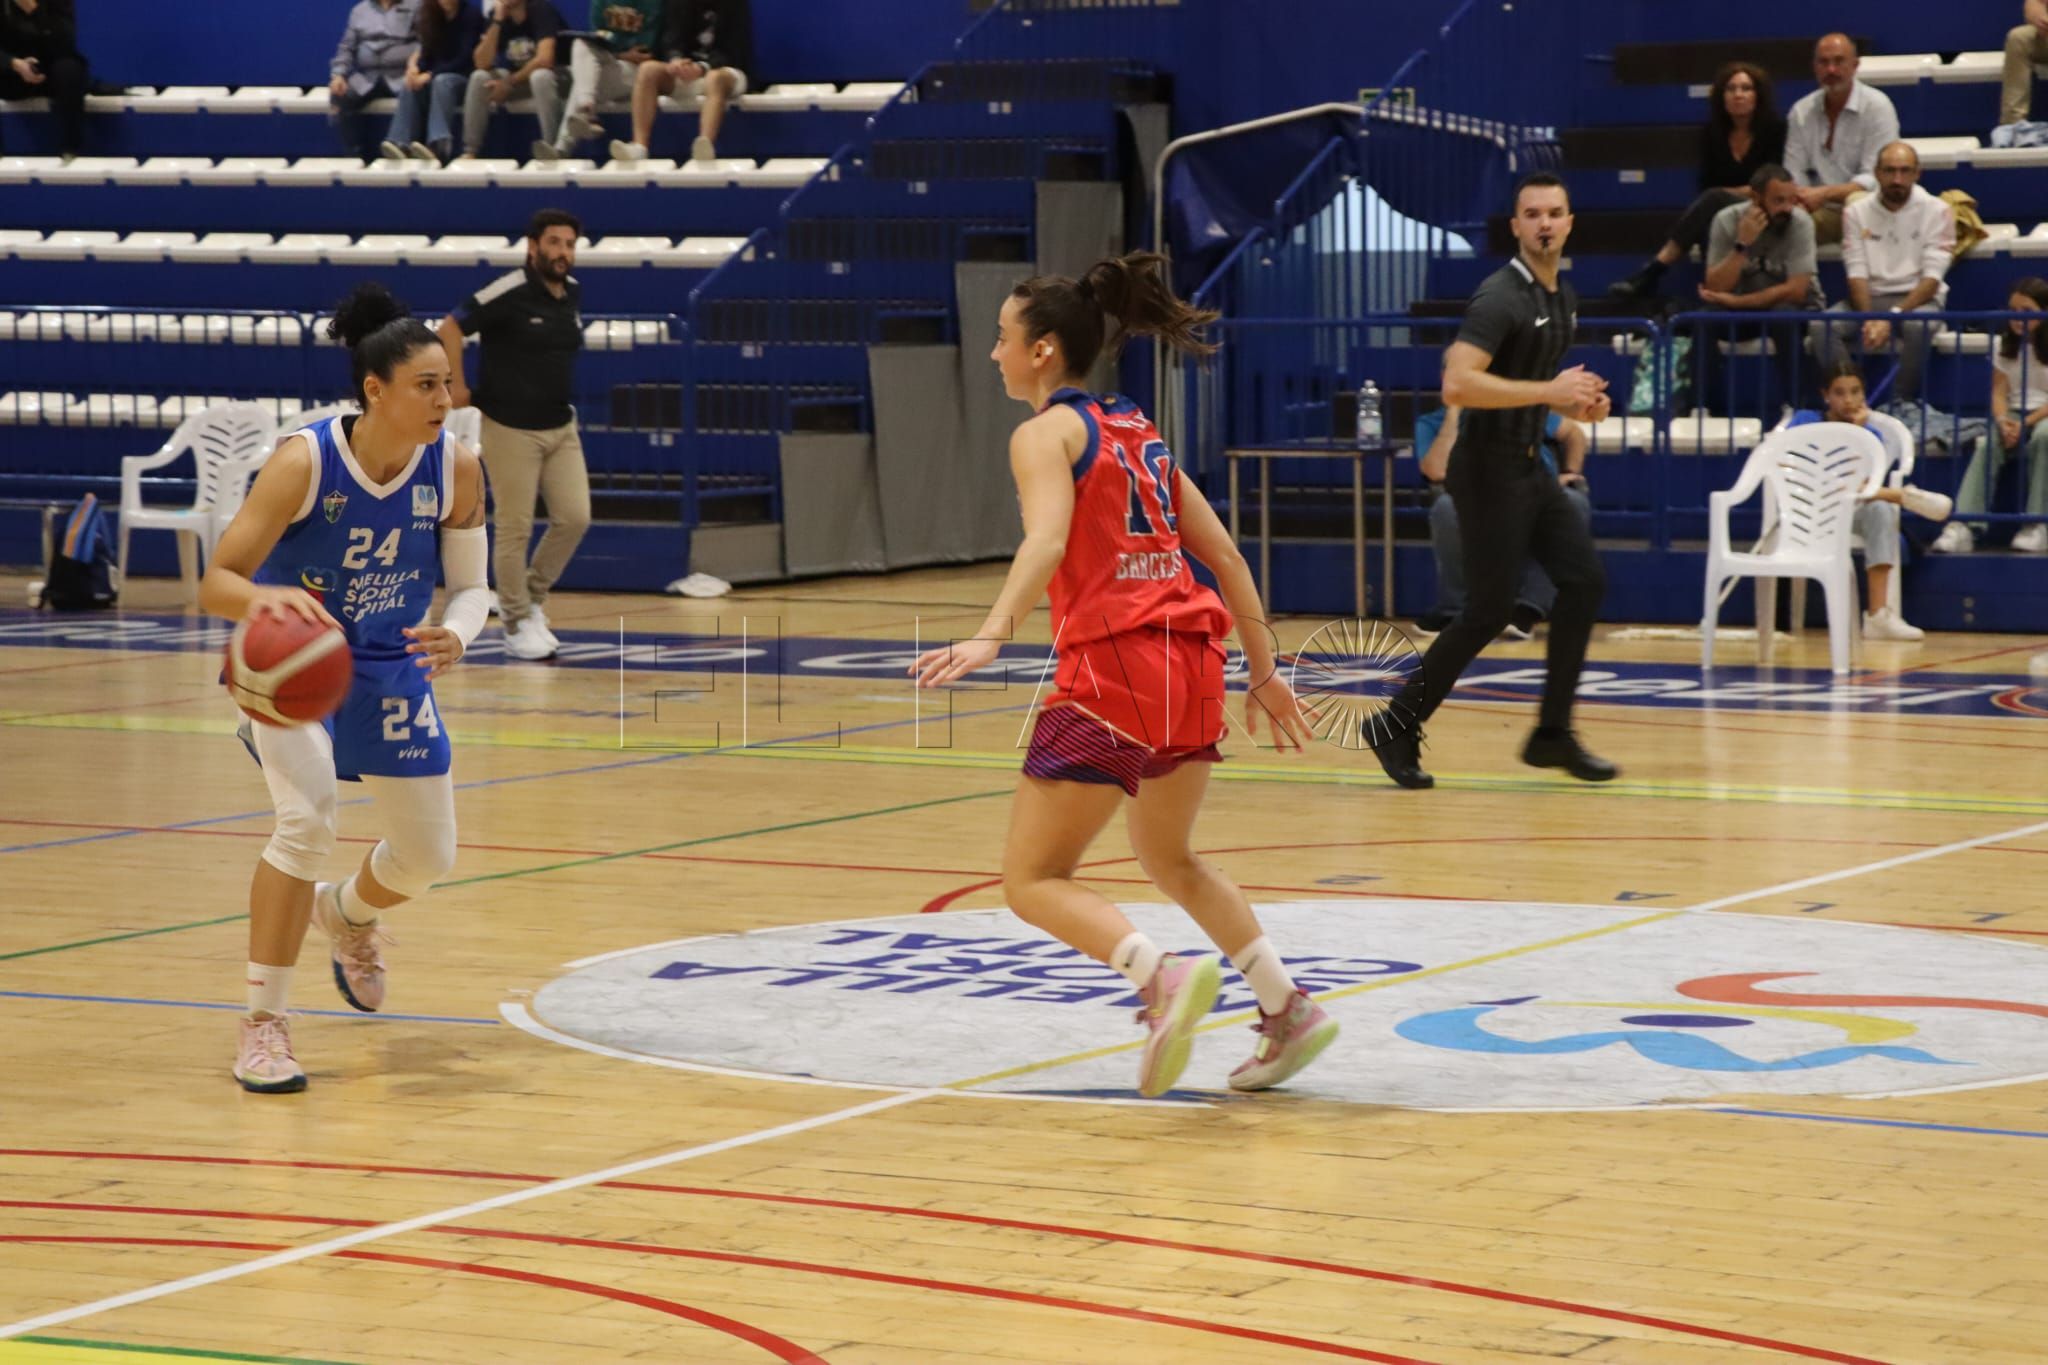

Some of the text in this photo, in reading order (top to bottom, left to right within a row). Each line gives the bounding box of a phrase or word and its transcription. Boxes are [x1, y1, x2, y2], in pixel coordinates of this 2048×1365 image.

[1113, 438, 1177, 537] 10
[342, 528, 402, 569] 24
[382, 693, 440, 741] 24
